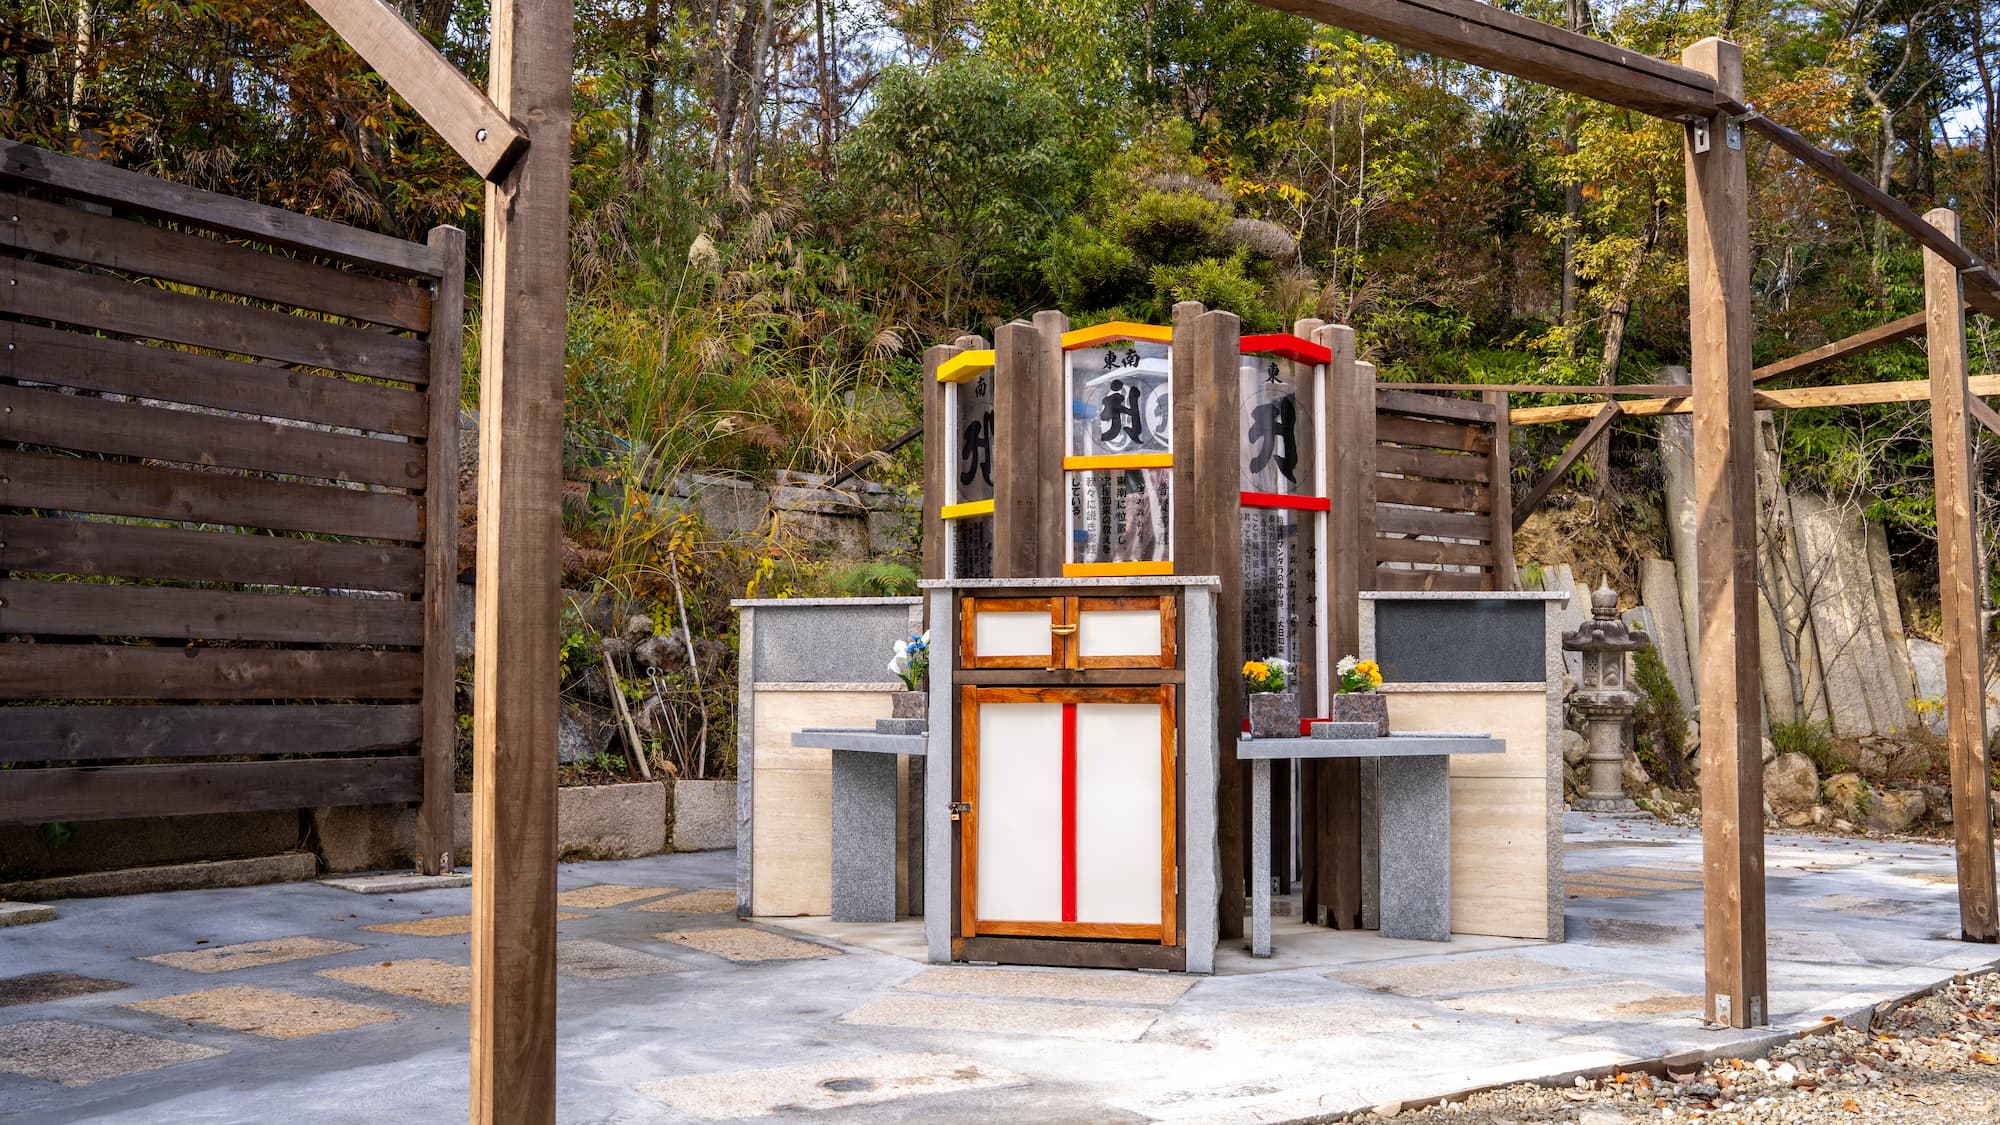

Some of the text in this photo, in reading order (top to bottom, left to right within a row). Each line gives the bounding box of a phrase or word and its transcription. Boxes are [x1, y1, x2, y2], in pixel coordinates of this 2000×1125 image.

[1102, 348, 1141, 370] 東南
[1265, 361, 1283, 384] 東
[974, 376, 987, 397] 南
